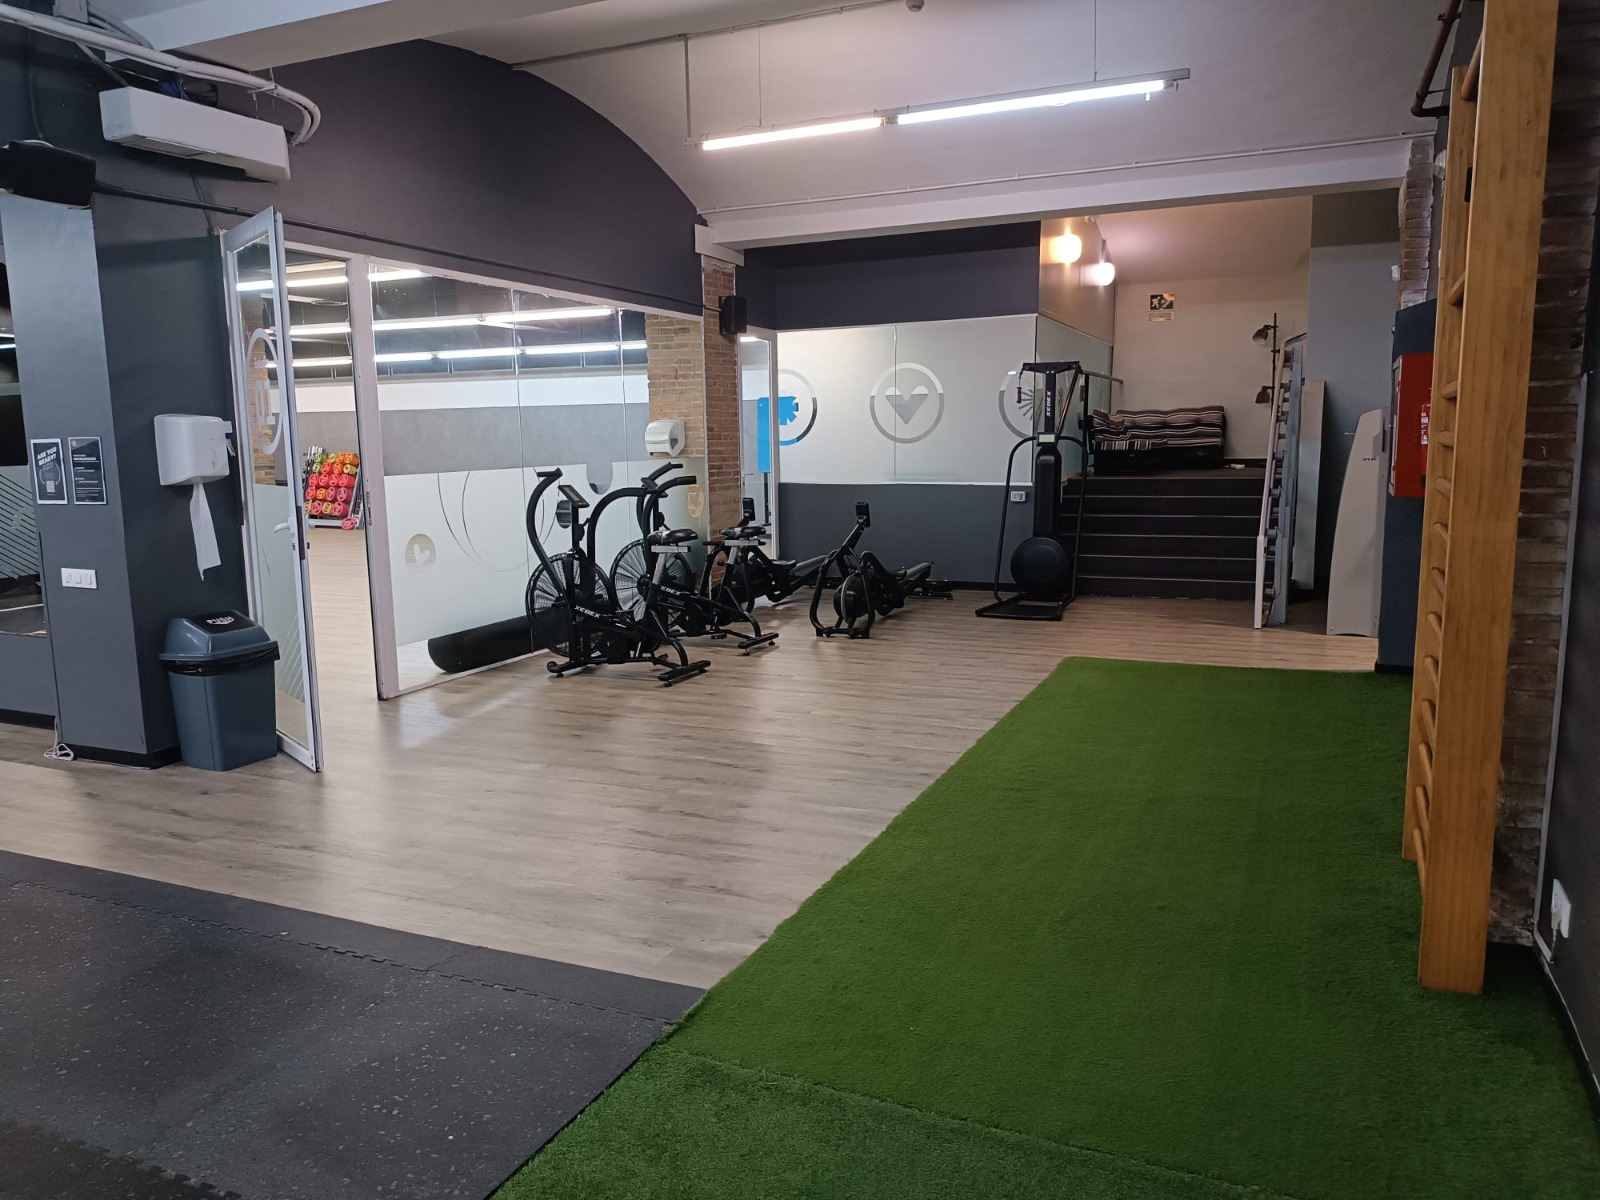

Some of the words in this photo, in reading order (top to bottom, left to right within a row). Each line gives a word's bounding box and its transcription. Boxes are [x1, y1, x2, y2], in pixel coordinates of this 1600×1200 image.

[37, 451, 47, 460] ARE
[46, 446, 57, 455] YOU
[38, 453, 57, 466] READY?
[573, 605, 601, 619] XEBEX
[206, 616, 233, 624] PUSH
